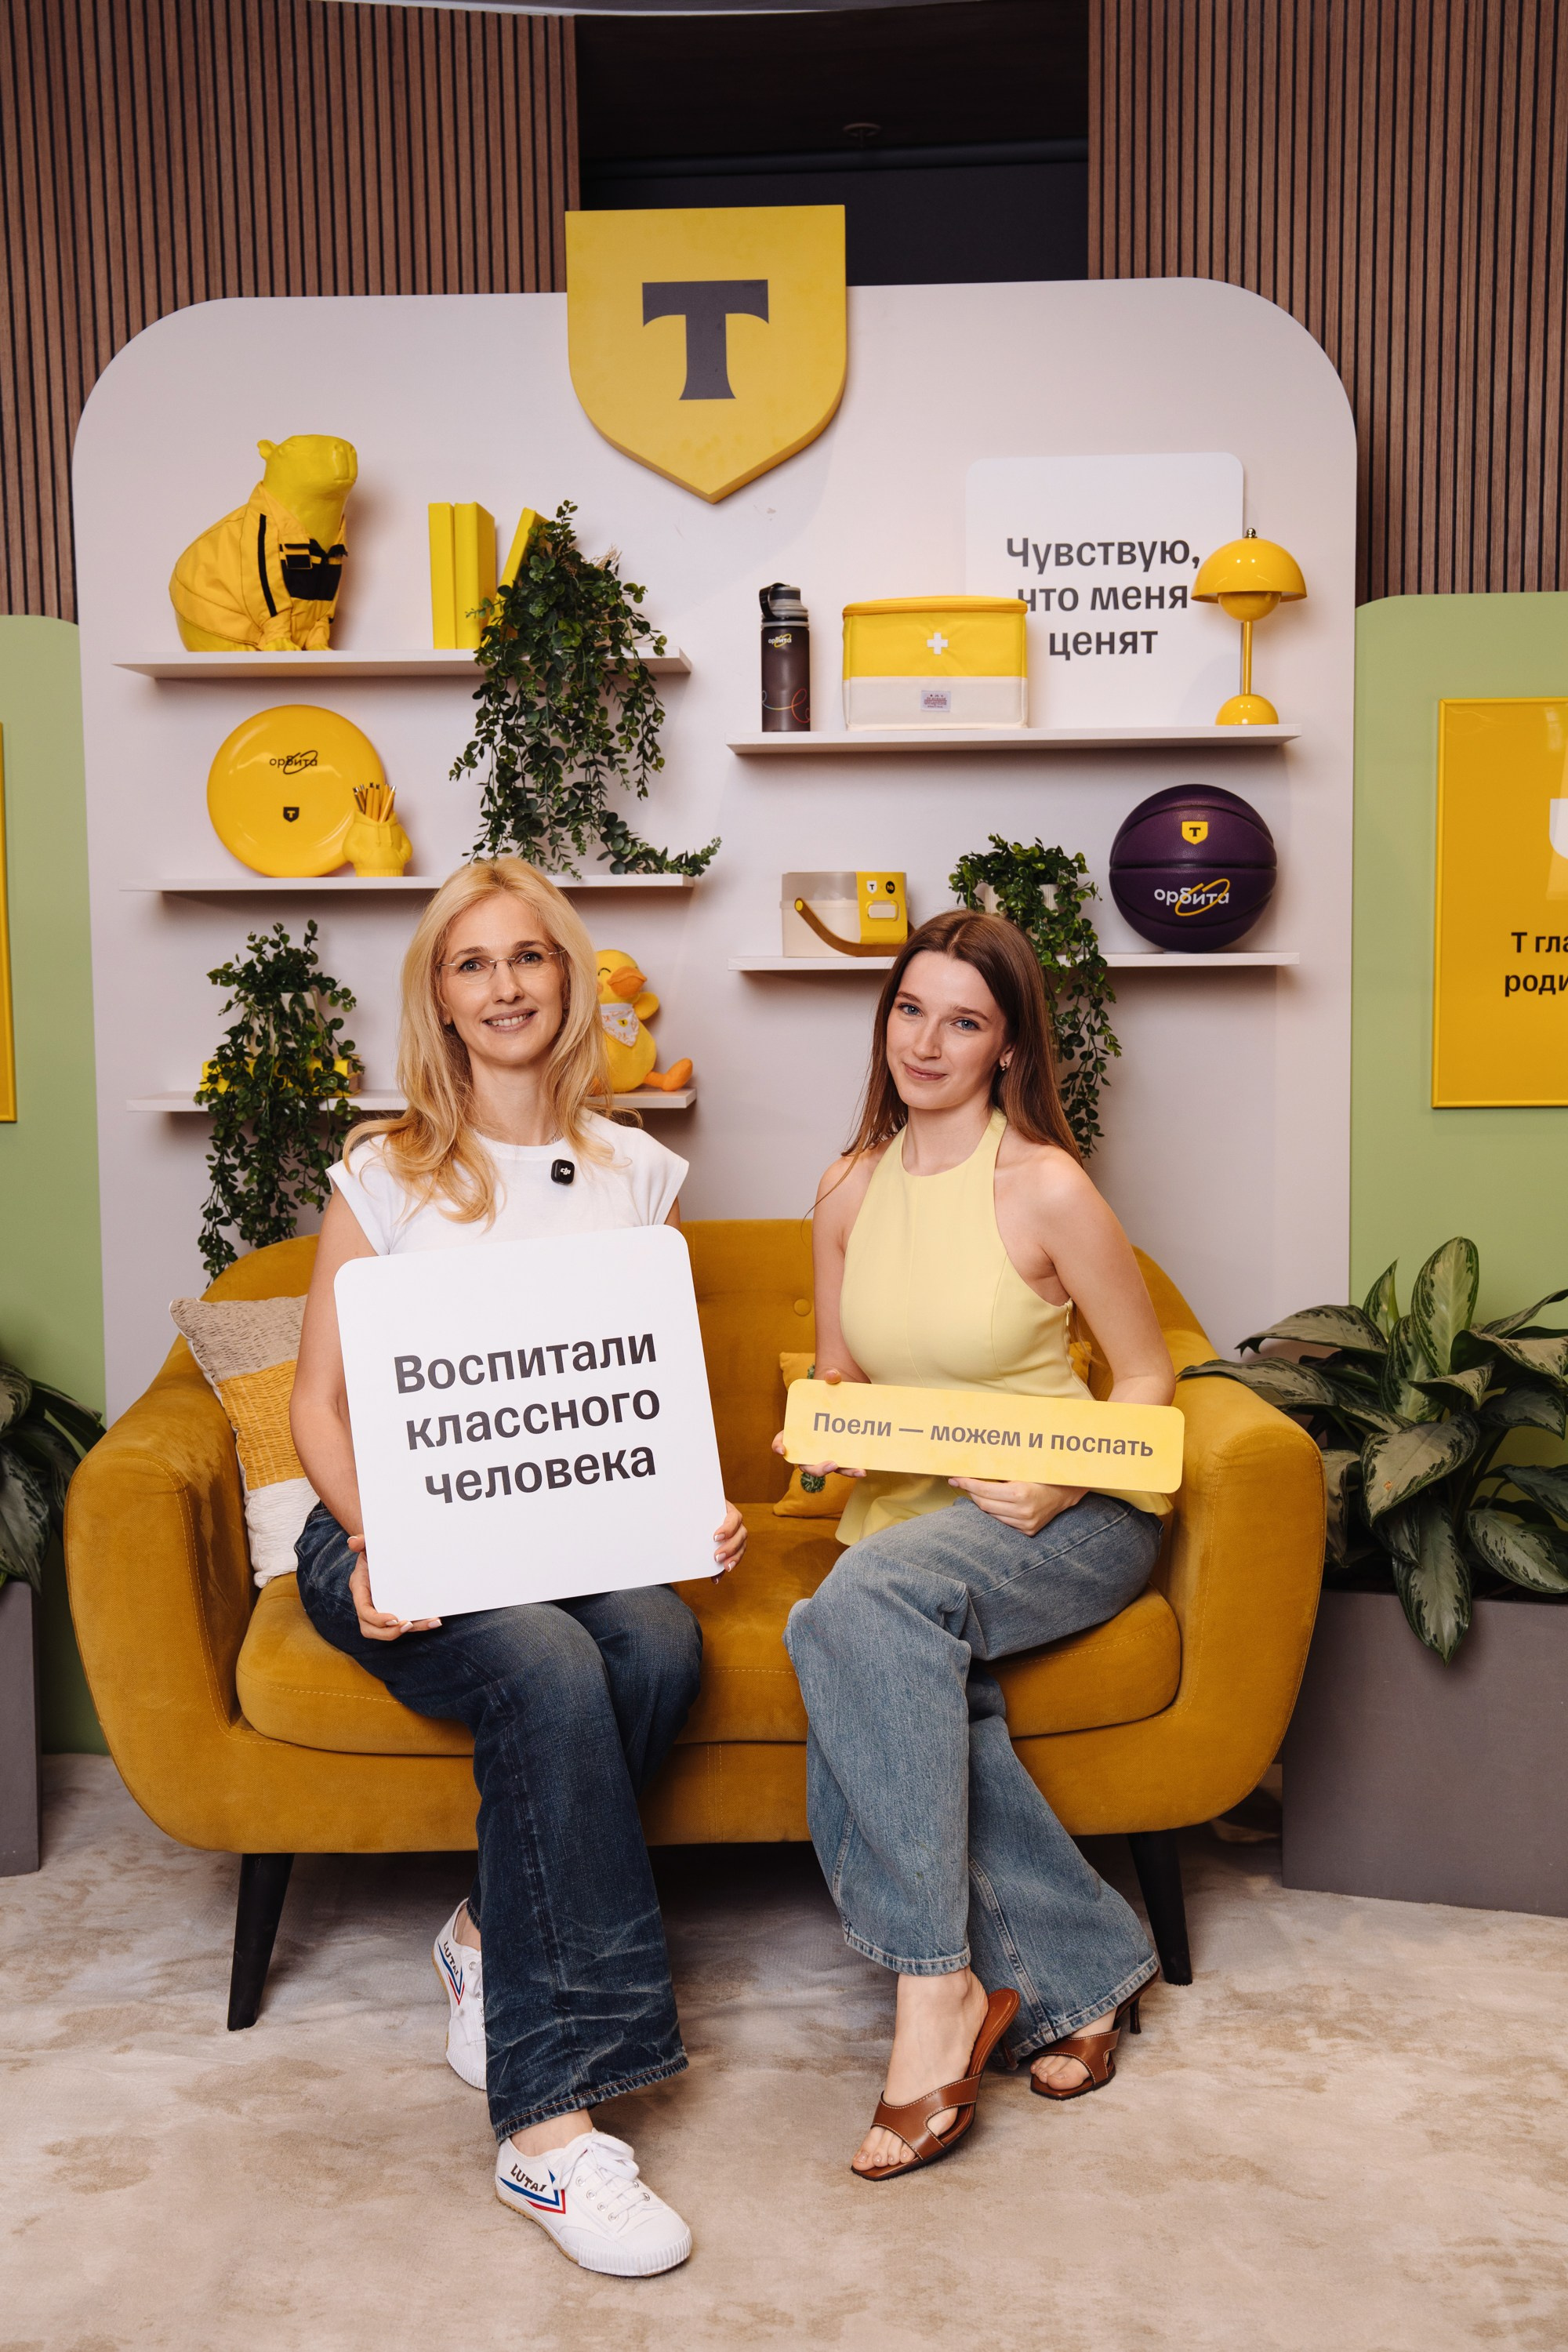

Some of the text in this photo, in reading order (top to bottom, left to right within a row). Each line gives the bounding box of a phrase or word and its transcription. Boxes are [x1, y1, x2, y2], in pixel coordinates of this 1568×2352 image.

[1007, 538, 1200, 575] Чувствую,
[1018, 585, 1188, 612] что меня
[1049, 630, 1159, 661] ценят
[1153, 885, 1230, 908] орбита
[1511, 931, 1528, 953] Т
[394, 1333, 657, 1395] Воспитали
[405, 1388, 660, 1450] классного
[813, 1412, 892, 1437] Поели
[931, 1425, 1021, 1447] можем
[1029, 1432, 1044, 1449] и
[1051, 1433, 1153, 1457] поспать
[424, 1446, 656, 1504] человека
[510, 2163, 547, 2193] LUTAI
